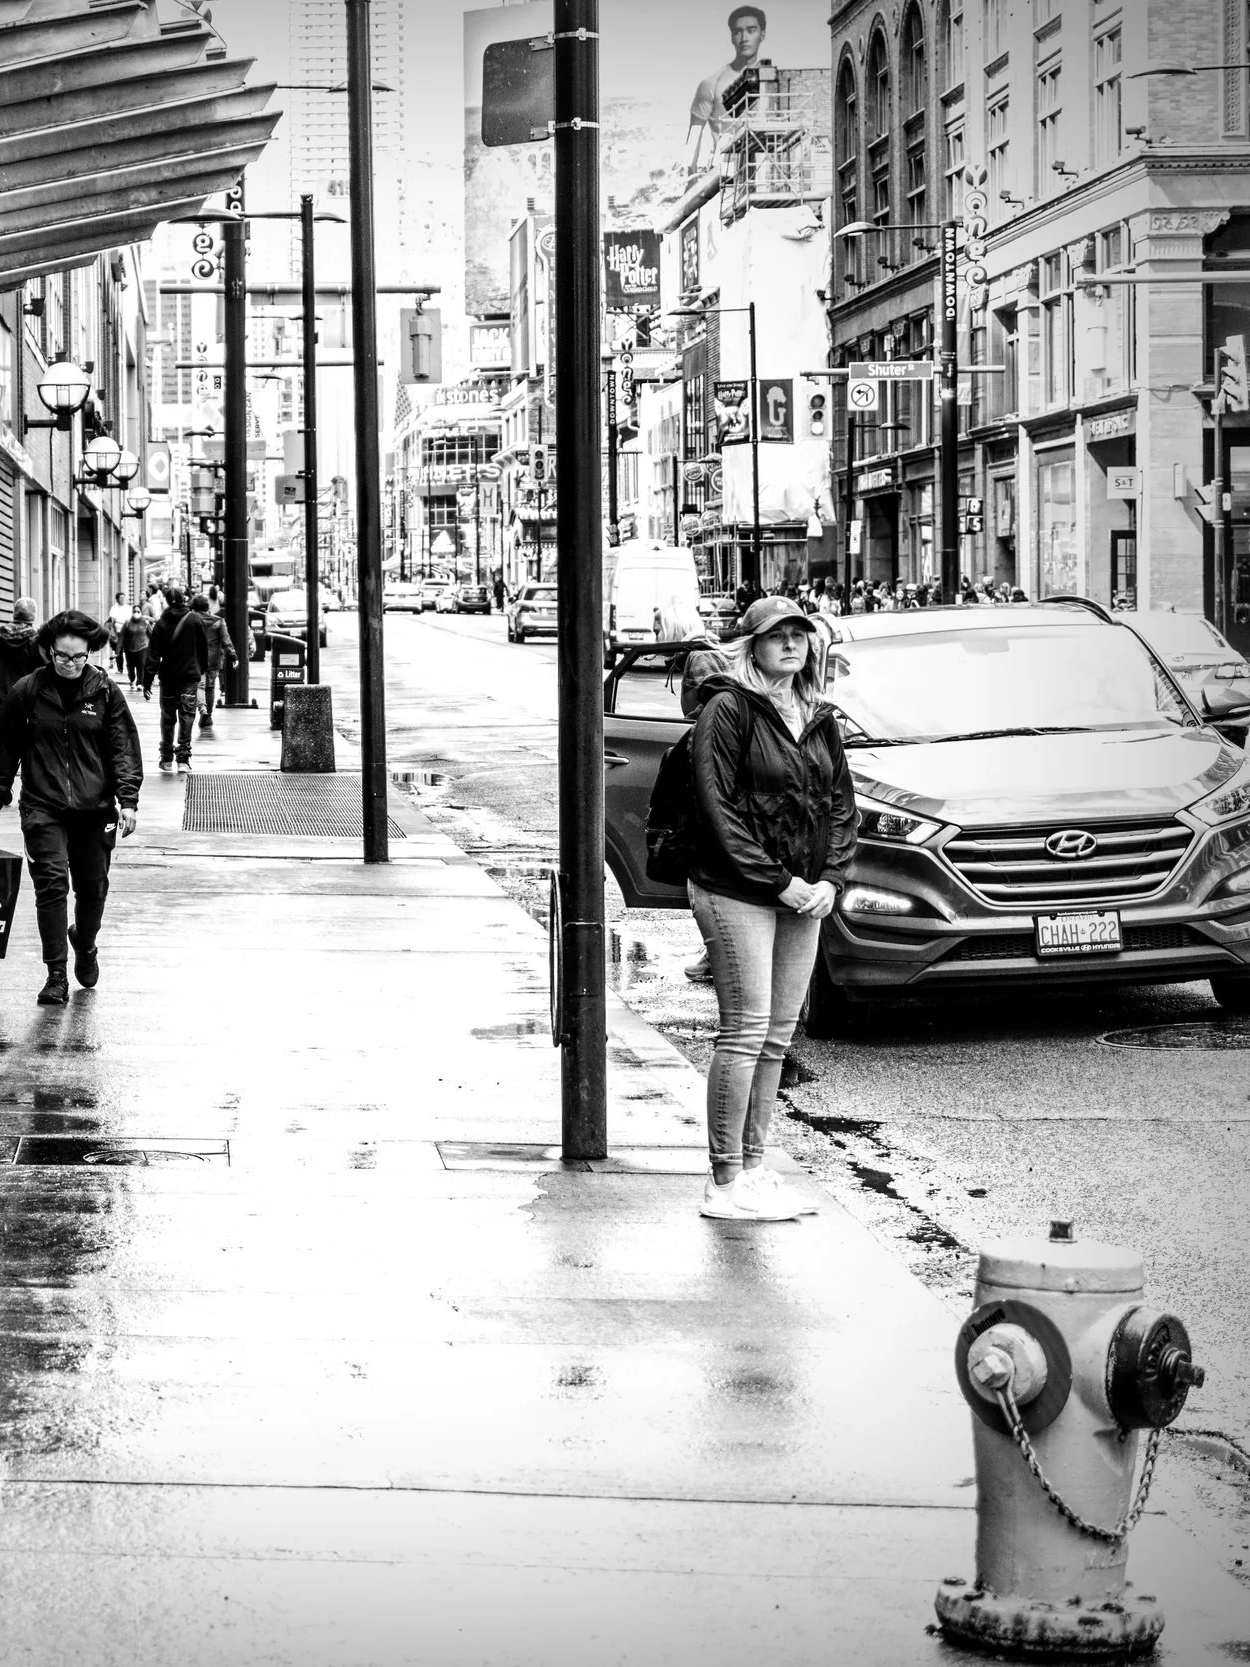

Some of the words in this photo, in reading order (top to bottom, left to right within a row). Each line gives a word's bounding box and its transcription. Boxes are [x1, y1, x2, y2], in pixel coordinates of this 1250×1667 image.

[606, 244, 644, 272] Harry
[620, 264, 658, 291] Potter
[945, 227, 955, 318] DOWNTOWN
[868, 364, 907, 376] Shuter
[285, 670, 301, 678] Litter
